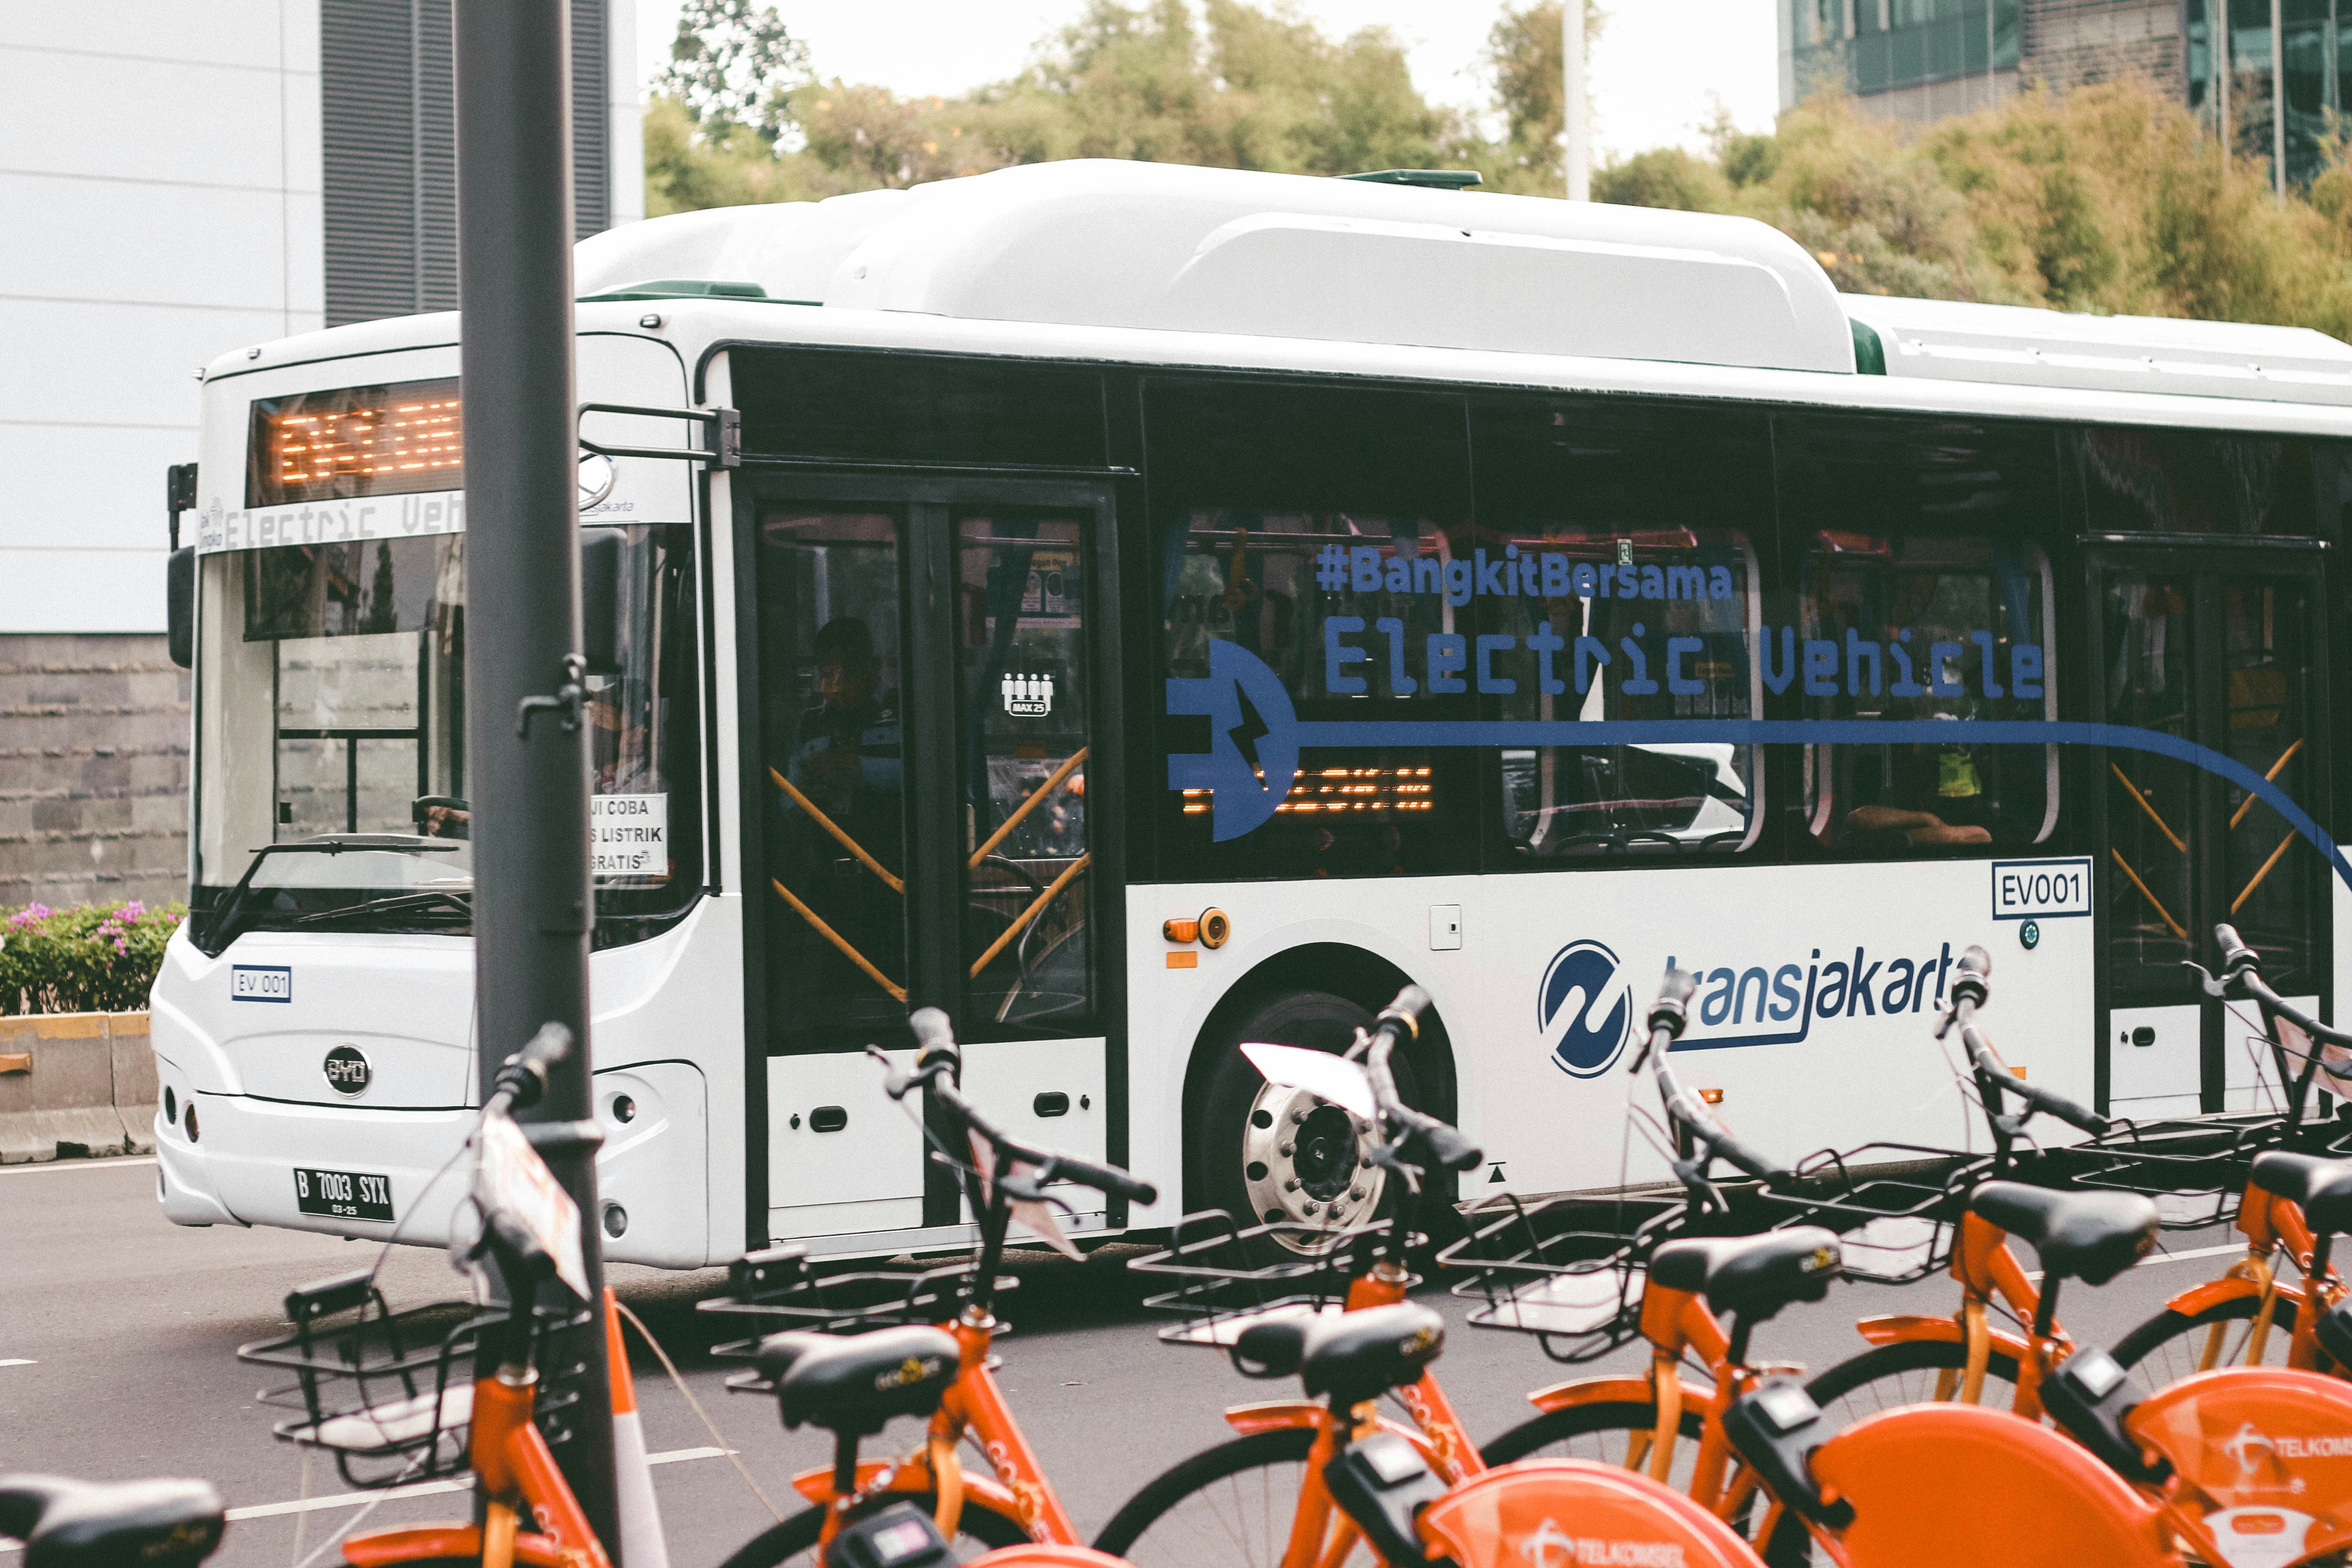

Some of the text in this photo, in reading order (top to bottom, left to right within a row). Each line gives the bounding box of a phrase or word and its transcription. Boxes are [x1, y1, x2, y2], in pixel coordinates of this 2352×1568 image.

[225, 505, 377, 550] Electric
[1316, 544, 1732, 606] #BangkitBersama
[1324, 616, 2043, 698] Electric Vehicle
[1012, 703, 1044, 712] MAX 25
[591, 800, 649, 815] JI COBA
[602, 827, 662, 842] LISTRIK
[2003, 873, 2079, 905] EV001
[239, 974, 287, 994] EV 001
[1666, 940, 1969, 1052] ansjakart
[327, 1059, 365, 1082] BYD
[297, 1171, 389, 1204] B 7003 SYX
[331, 1204, 358, 1215] 03-25
[2275, 1438, 2352, 1457] TELKOMS
